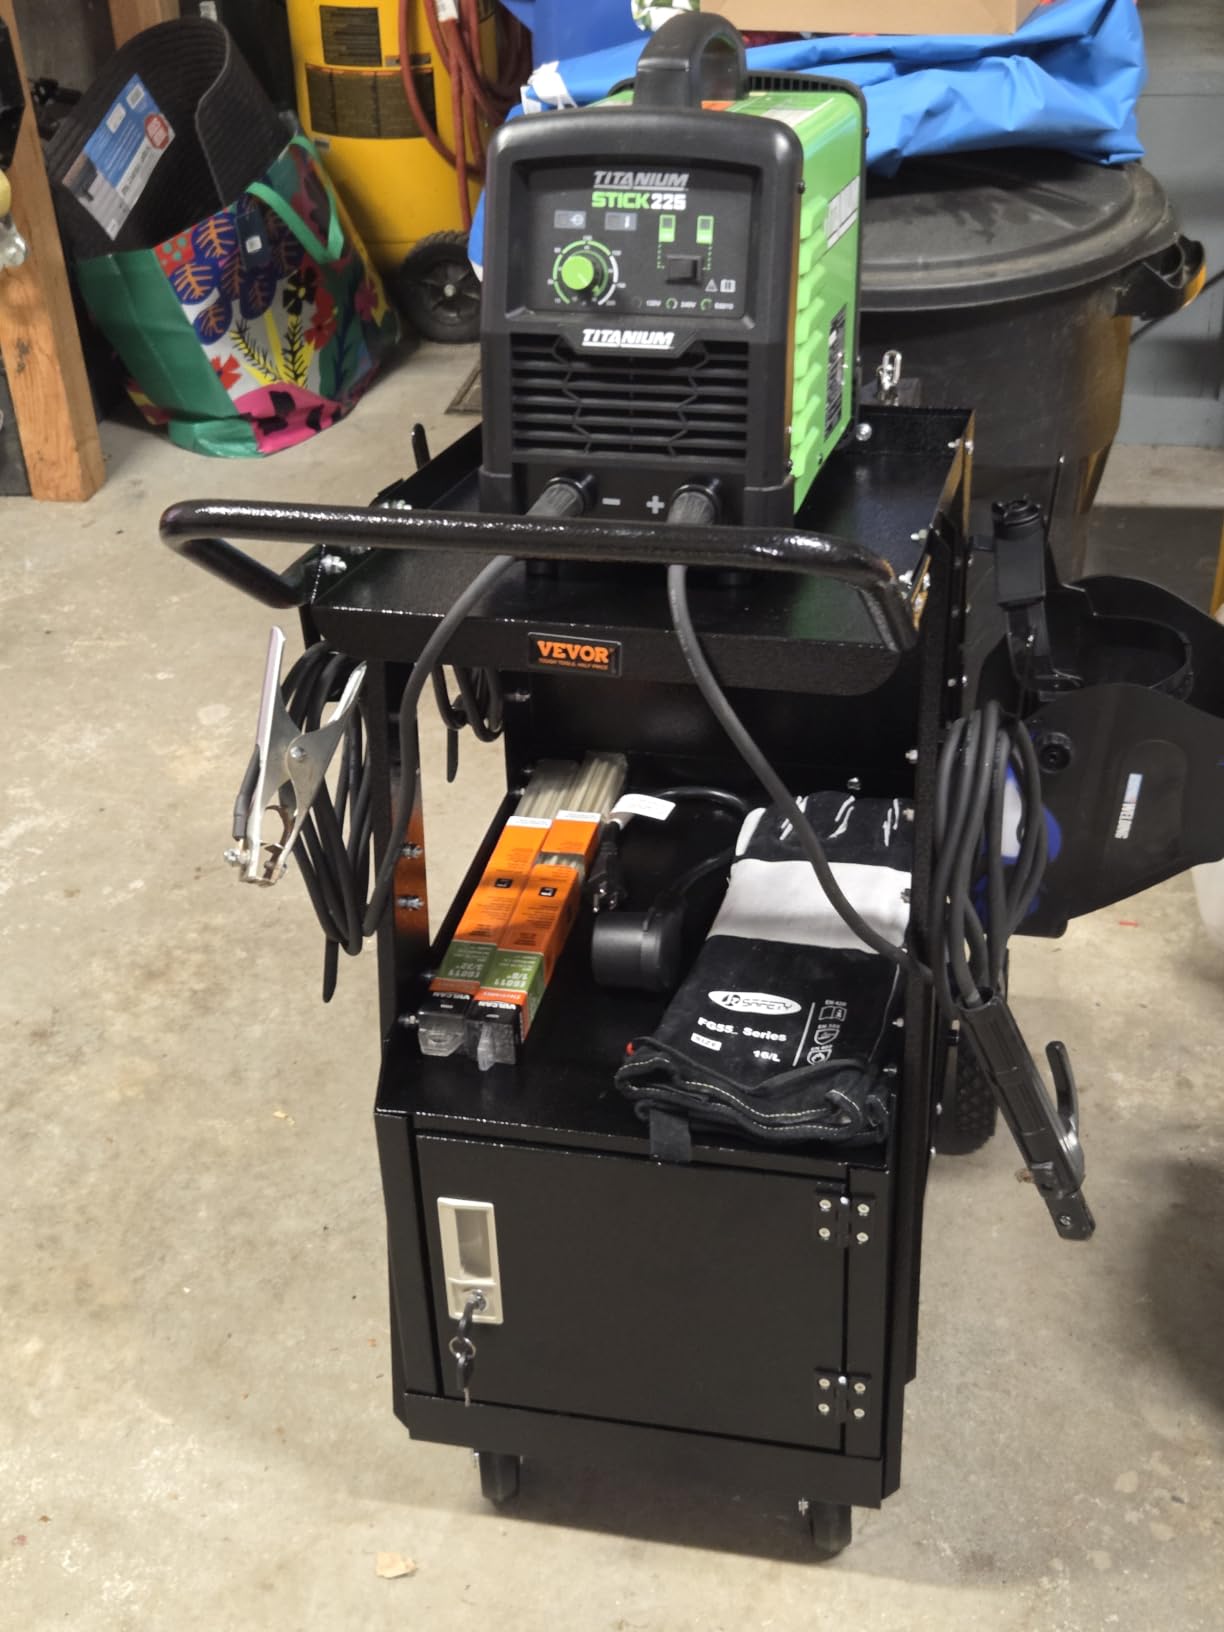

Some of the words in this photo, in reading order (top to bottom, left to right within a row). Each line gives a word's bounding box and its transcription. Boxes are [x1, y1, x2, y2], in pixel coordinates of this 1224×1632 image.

[593, 170, 690, 189] TITANIUM
[581, 328, 675, 348] TITANIUM
[536, 640, 609, 664] VEVOR
[431, 991, 471, 1001] VULCAN
[478, 1000, 517, 1010] VULCAN
[742, 1026, 788, 1043] Series
